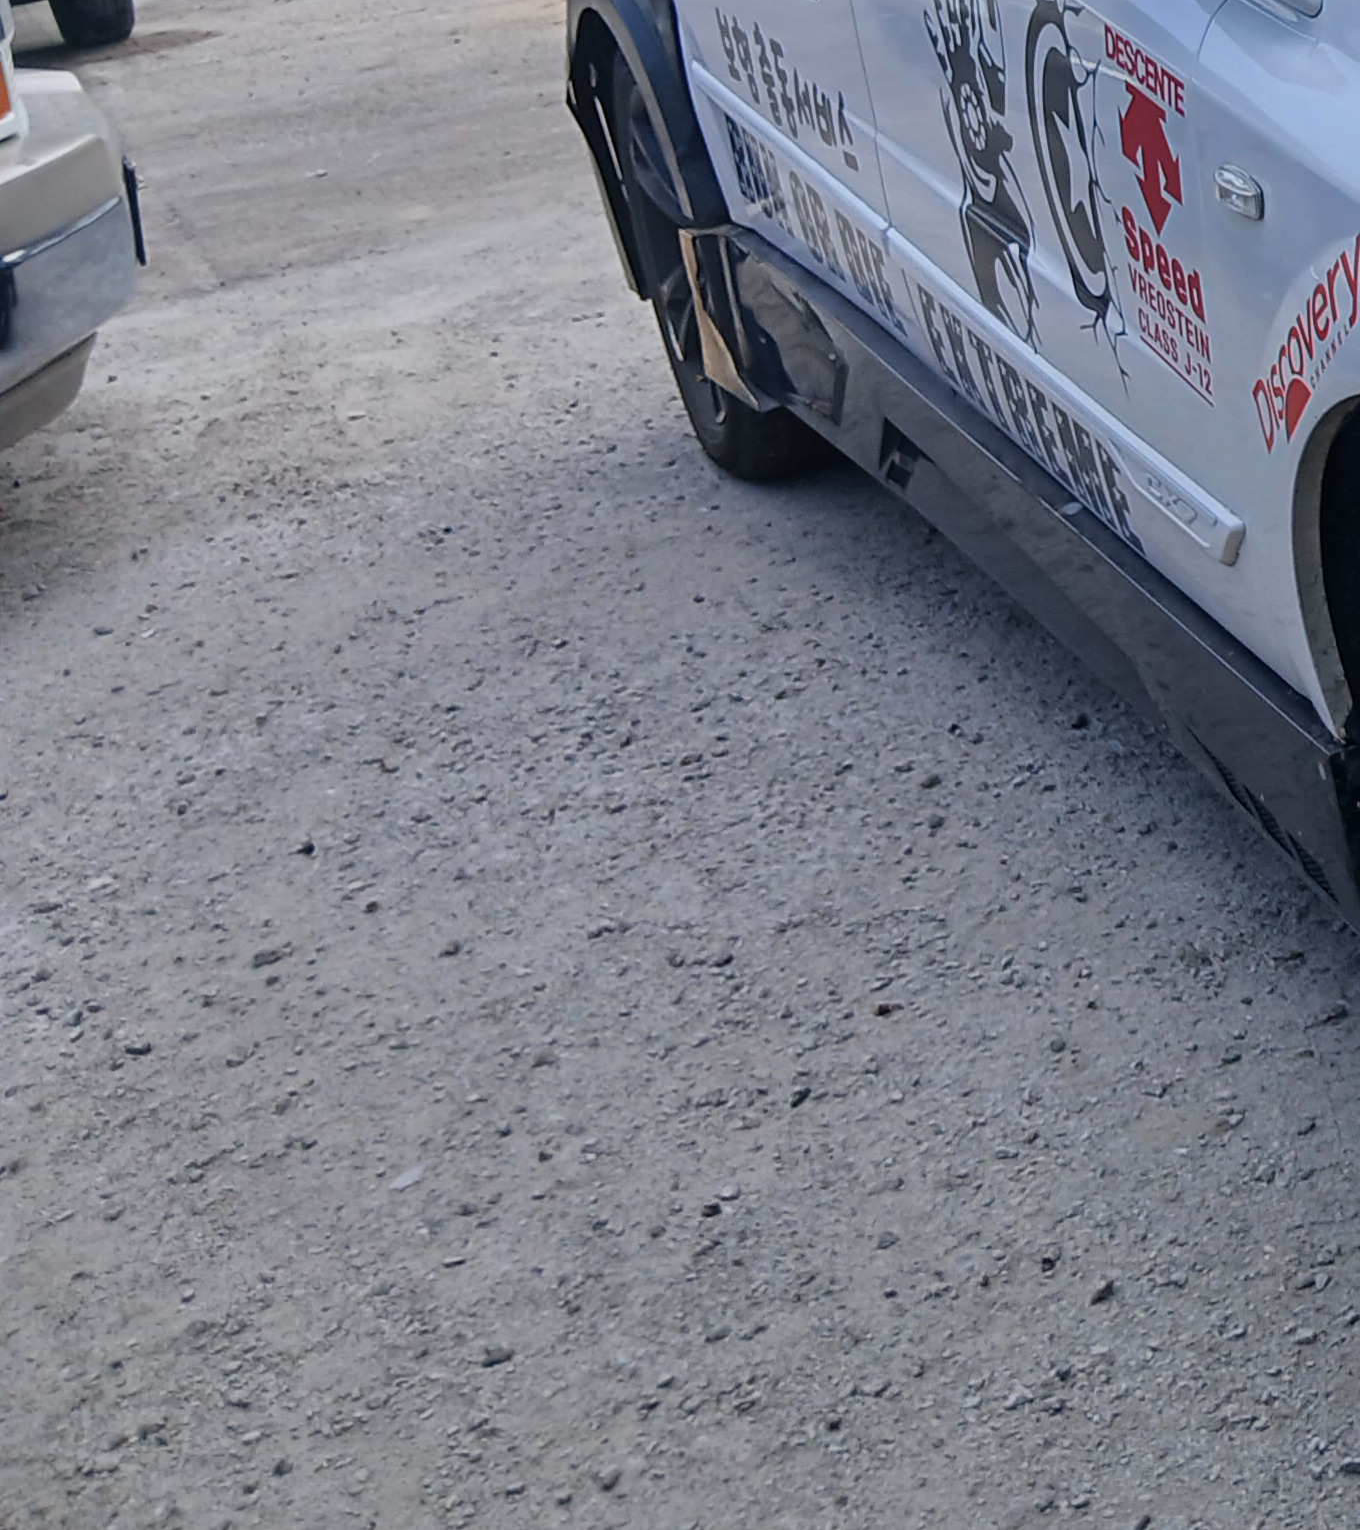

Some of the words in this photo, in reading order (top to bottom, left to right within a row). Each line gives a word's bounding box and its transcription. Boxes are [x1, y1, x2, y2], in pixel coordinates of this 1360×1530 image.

[715, 6, 860, 172] 보험출동서비스
[1104, 23, 1187, 118] DESCENTE
[789, 170, 847, 283] OR
[833, 208, 909, 338] DIE
[1121, 205, 1207, 324] Speed
[1128, 263, 1212, 364] VREOSTEIN
[1138, 308, 1180, 362] CLASS
[1184, 346, 1214, 396] J-12
[1310, 324, 1351, 390] CHANNEL
[916, 282, 1148, 548] EXTREME
